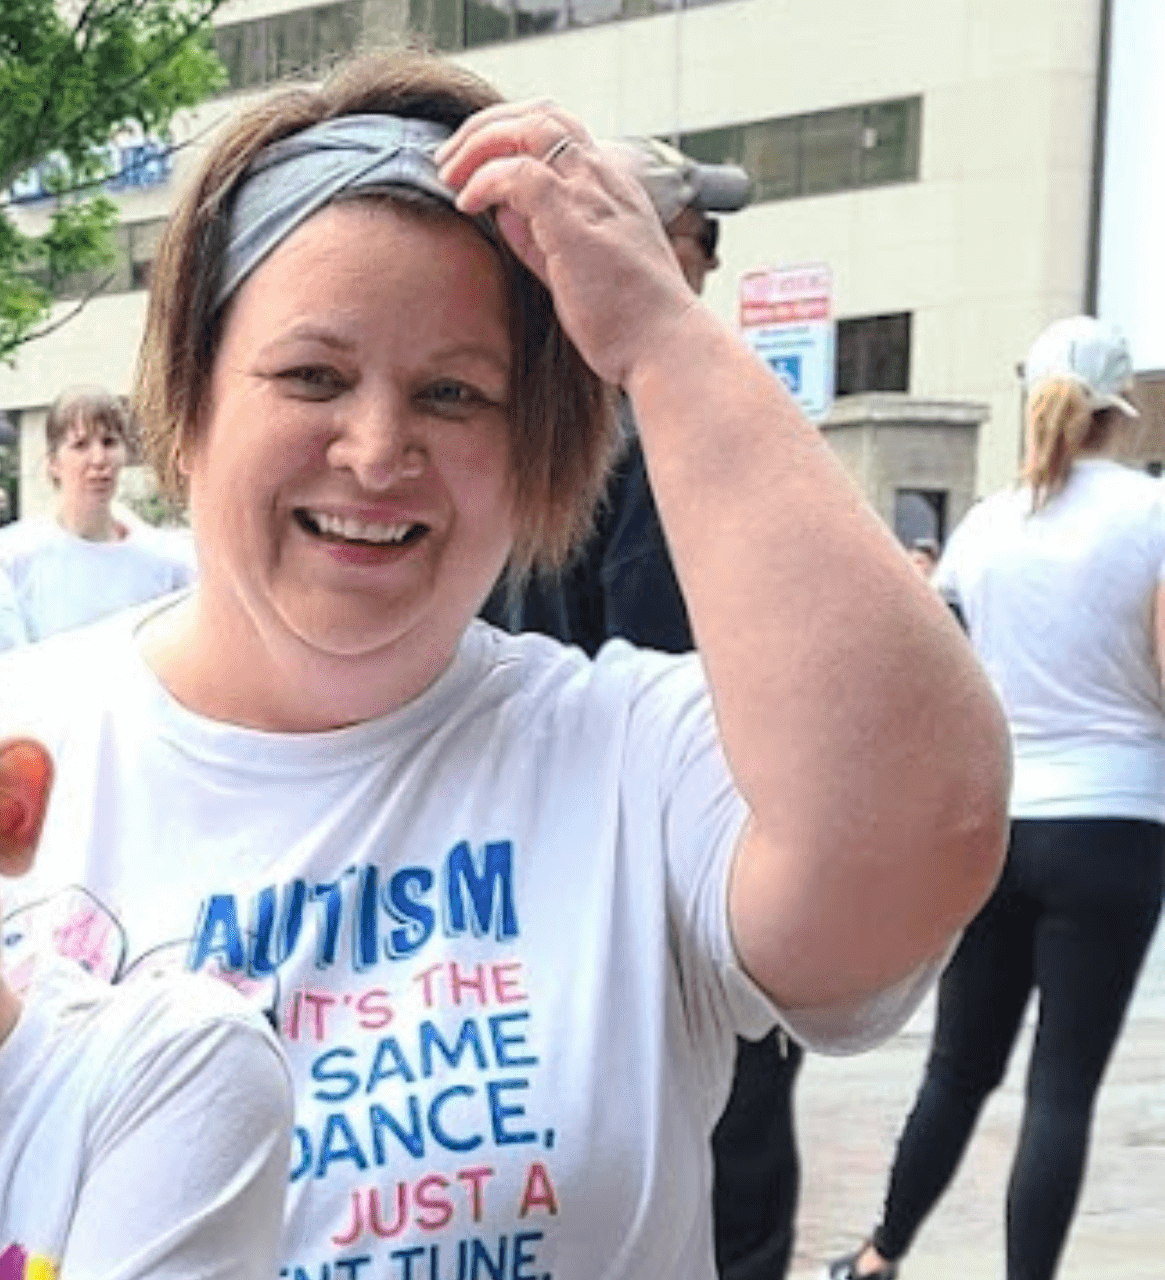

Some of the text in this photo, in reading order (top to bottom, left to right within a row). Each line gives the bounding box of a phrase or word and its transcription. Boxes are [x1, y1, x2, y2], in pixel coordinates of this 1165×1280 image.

[187, 839, 519, 978] AUTISM
[289, 960, 529, 1040] IT'S THE
[310, 1010, 539, 1103] SAME
[331, 1162, 558, 1246] JUST A
